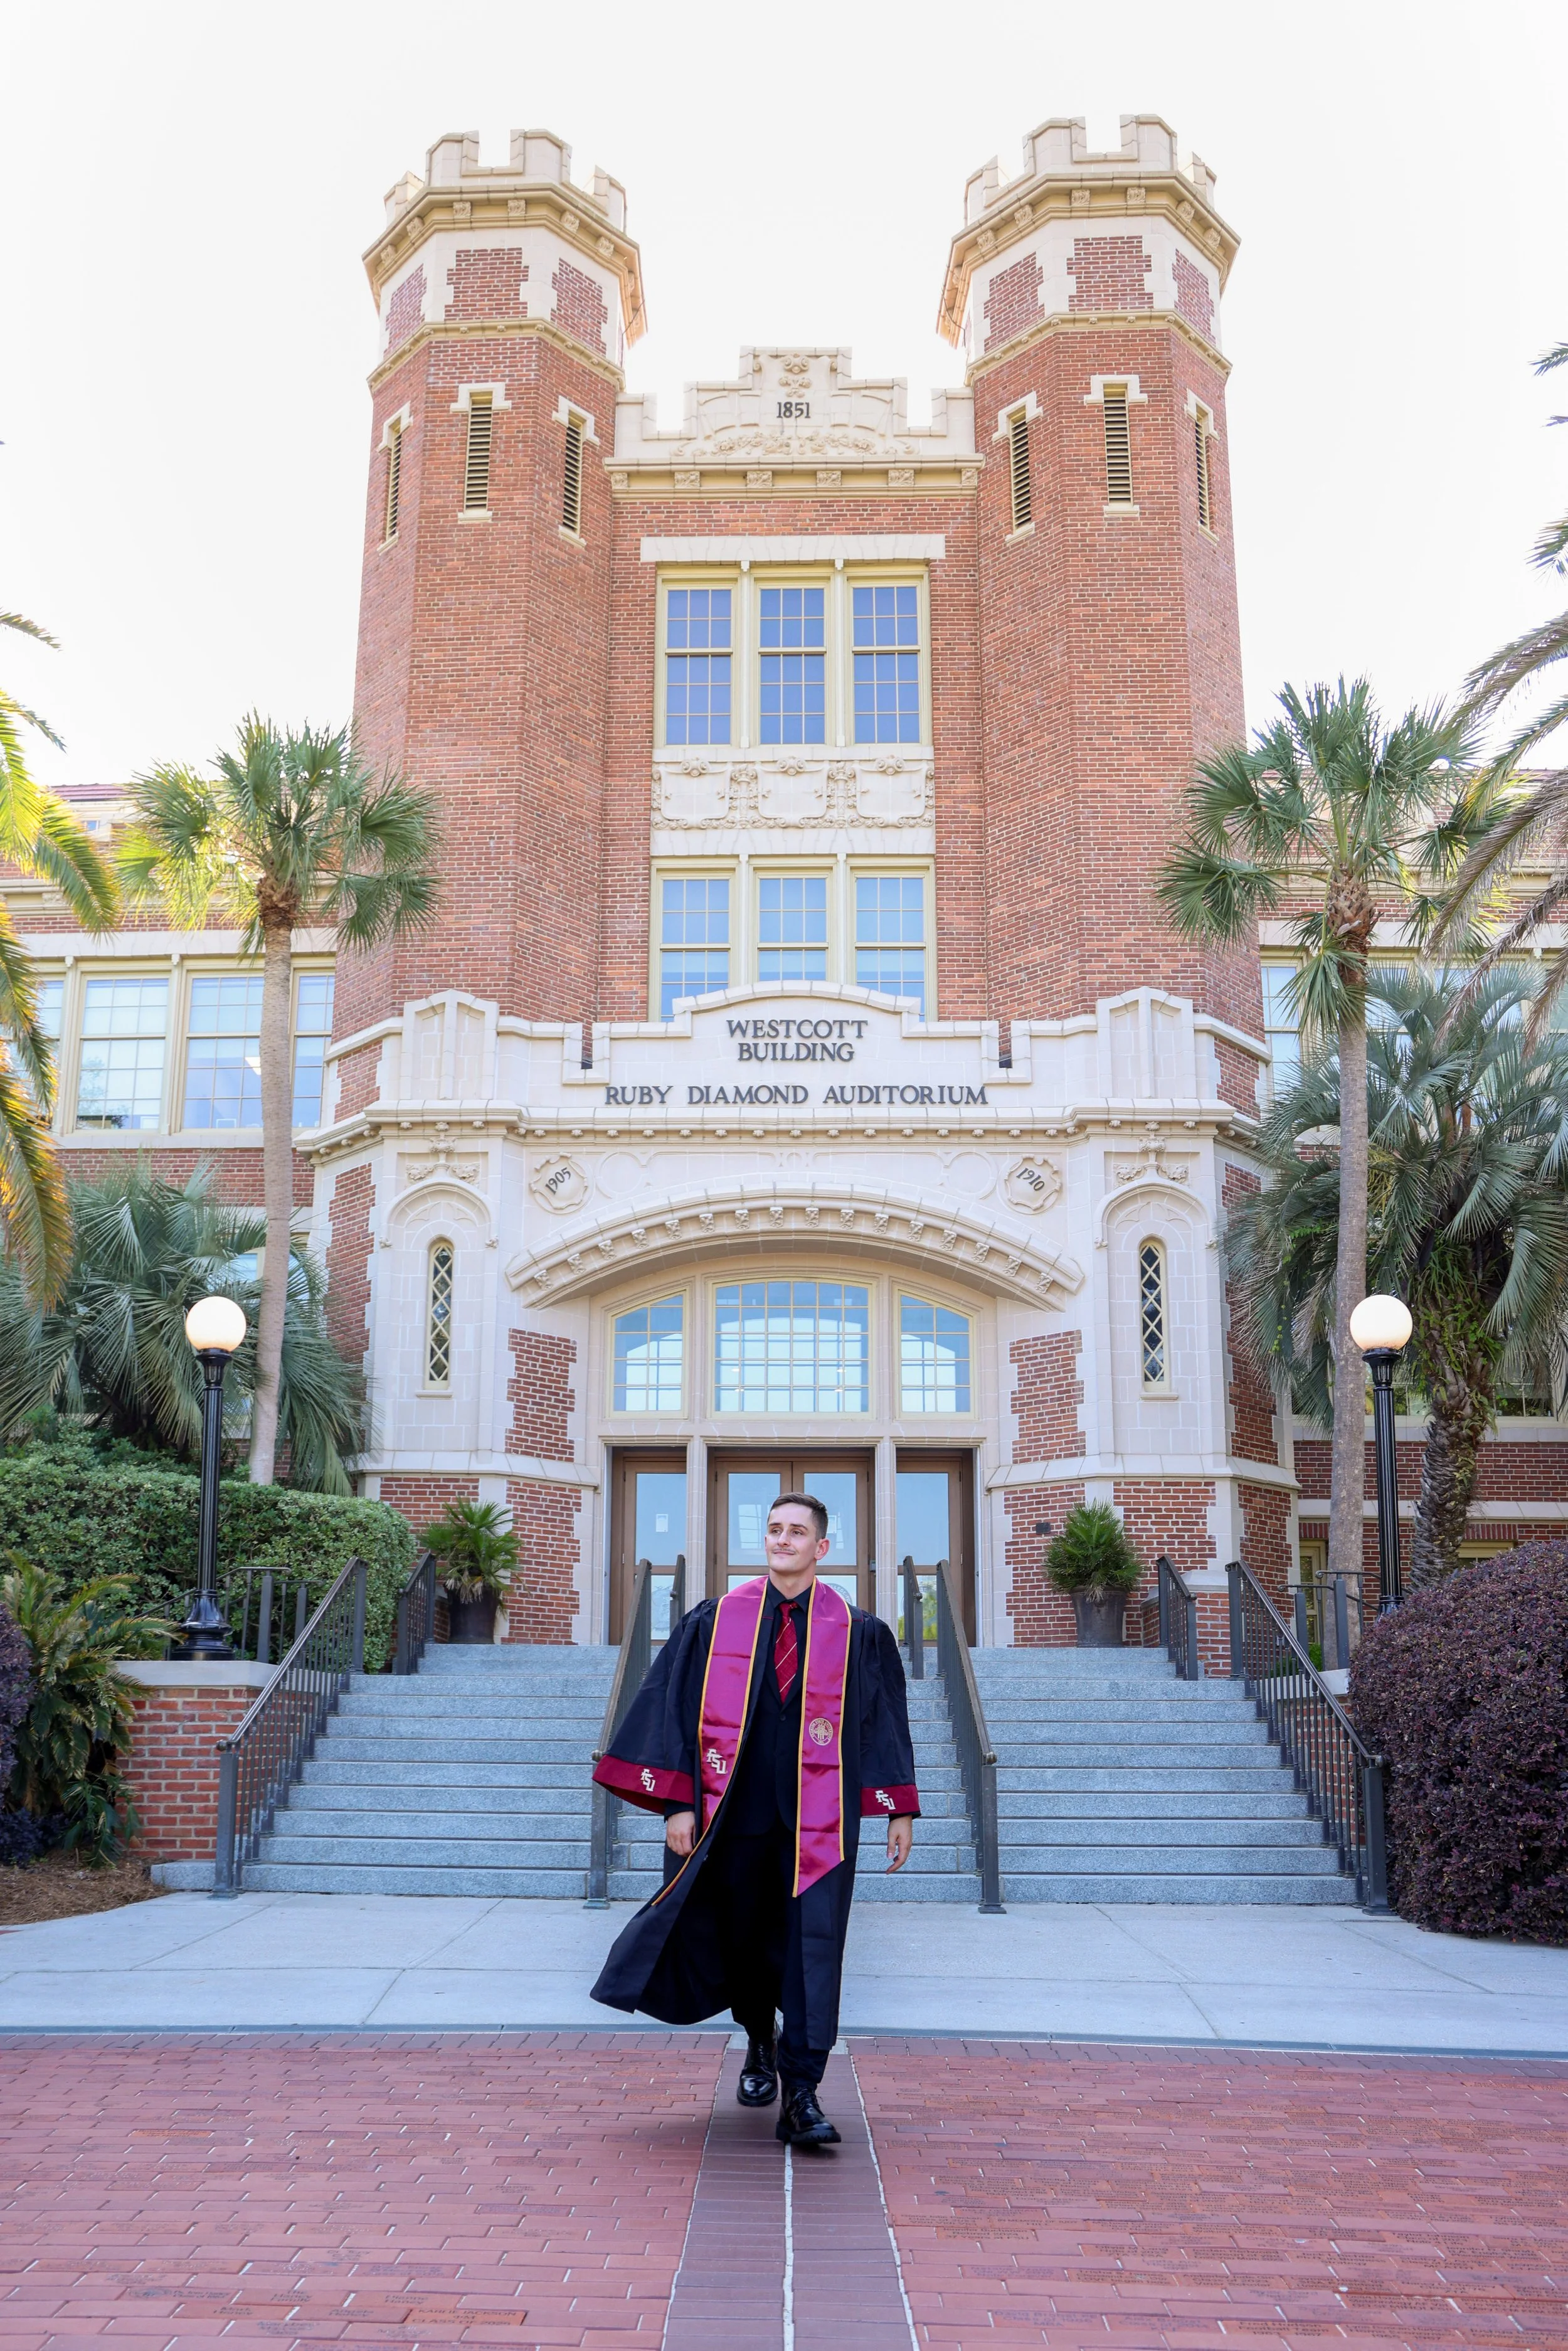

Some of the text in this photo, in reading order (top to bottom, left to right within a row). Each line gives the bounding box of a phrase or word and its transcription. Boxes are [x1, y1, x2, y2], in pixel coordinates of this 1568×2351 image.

[776, 401, 811, 418] 1851
[726, 1019, 868, 1039] WESTCOTT
[738, 1042, 855, 1061] BUILDING
[605, 1085, 988, 1105] RUBY DIAMOND AUDITORIUM
[545, 1167, 571, 1195] 1905
[1016, 1167, 1044, 1191] 1910
[706, 1748, 727, 1774] FSU
[640, 1768, 655, 1792] FSU
[875, 1790, 896, 1810] FSU
